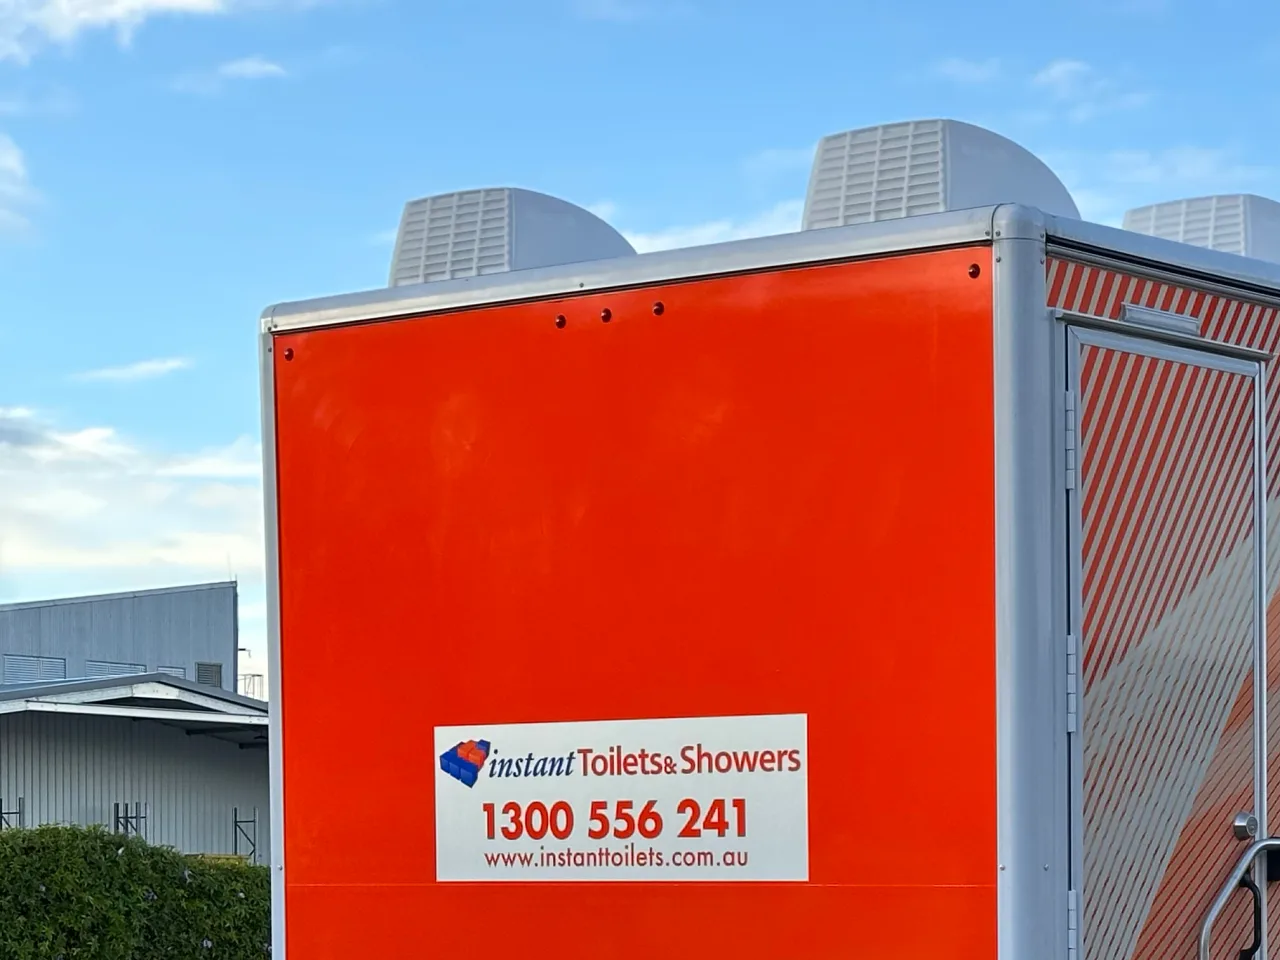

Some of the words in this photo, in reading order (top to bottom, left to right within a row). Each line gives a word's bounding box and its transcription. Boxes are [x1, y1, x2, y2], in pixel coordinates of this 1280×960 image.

[489, 748, 576, 778] instant
[577, 745, 662, 776] Toilets
[680, 743, 801, 774] Showers
[482, 801, 575, 841] 1300
[588, 799, 664, 839] 556
[676, 798, 747, 838] 241
[484, 843, 749, 868] www.instanttoilets.com.au
